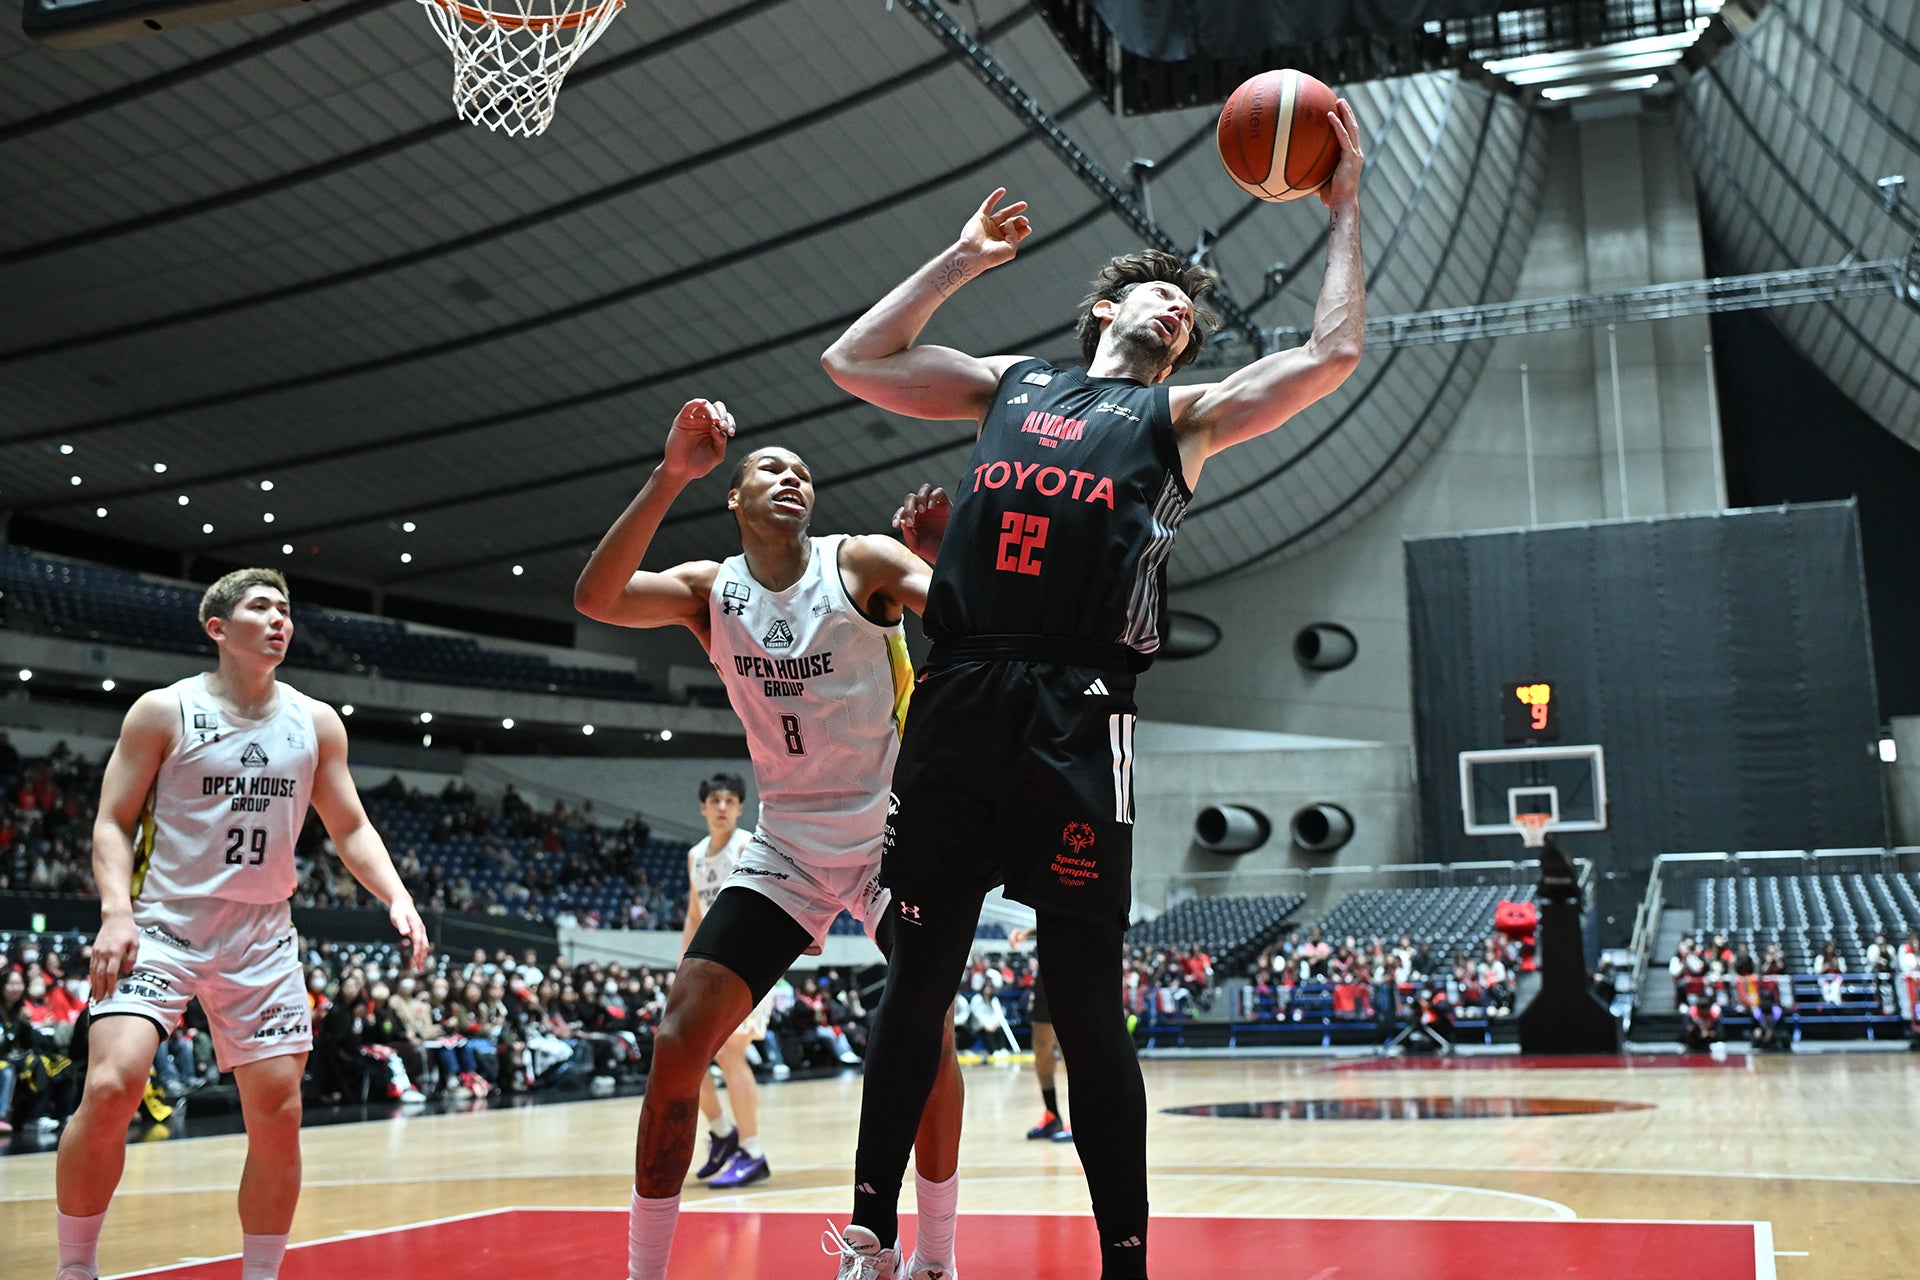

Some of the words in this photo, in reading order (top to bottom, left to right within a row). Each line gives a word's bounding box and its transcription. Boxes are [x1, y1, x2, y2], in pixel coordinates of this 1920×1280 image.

[1021, 411, 1089, 441] ALVARK
[973, 461, 1115, 511] TOYOTA
[996, 511, 1050, 576] 22
[734, 655, 775, 679] OPEN
[776, 652, 834, 680] HOUSE
[764, 680, 804, 697] GROUP
[780, 713, 806, 756] 8
[202, 777, 246, 795] OPEN
[250, 777, 296, 798] HOUSE
[231, 797, 270, 812] GROUP
[225, 828, 267, 864] 29
[1051, 863, 1099, 878] Olympics
[1055, 854, 1097, 868] Special
